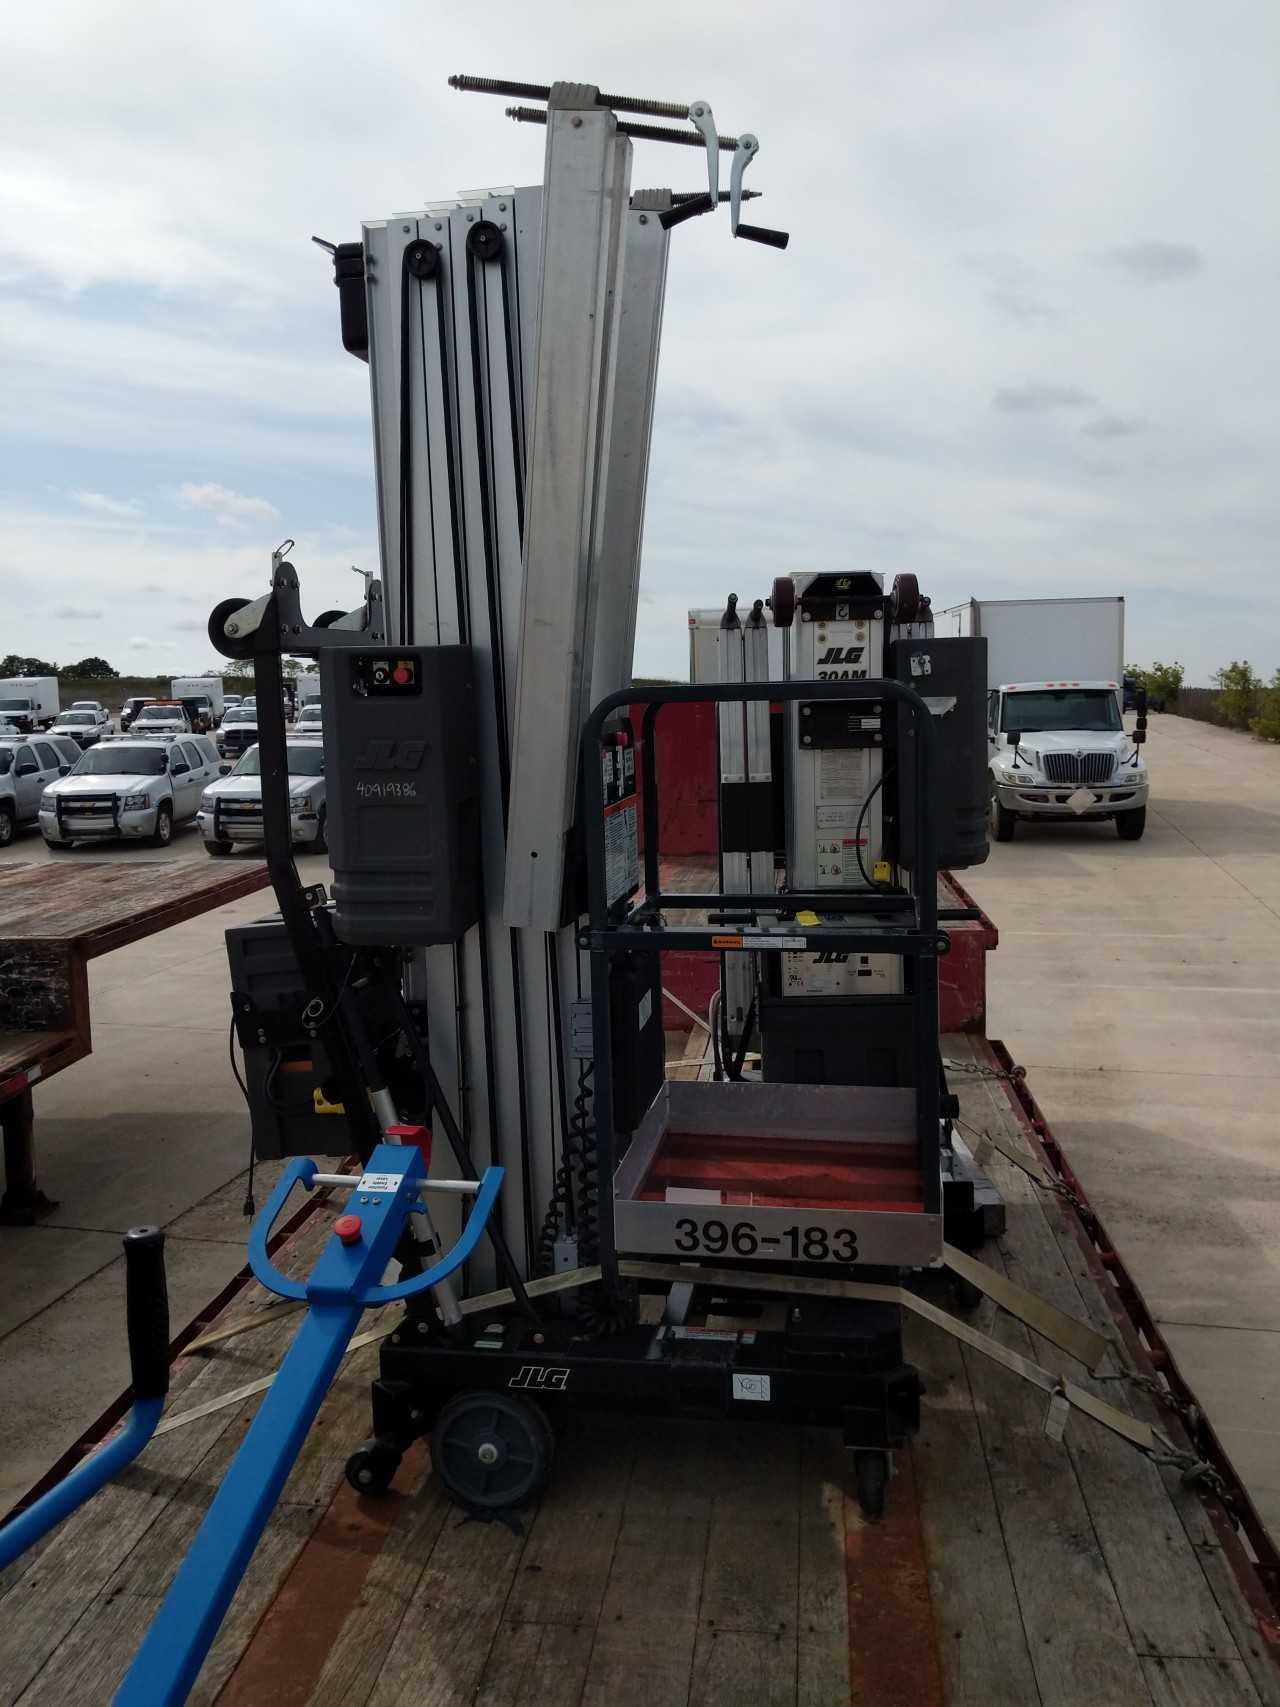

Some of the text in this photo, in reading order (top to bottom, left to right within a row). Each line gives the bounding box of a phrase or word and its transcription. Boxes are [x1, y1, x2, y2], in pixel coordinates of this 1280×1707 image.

[818, 647, 864, 665] JLG
[812, 952, 849, 964] JLG
[674, 1218, 859, 1263] 396-183
[508, 1366, 571, 1391] JLG
